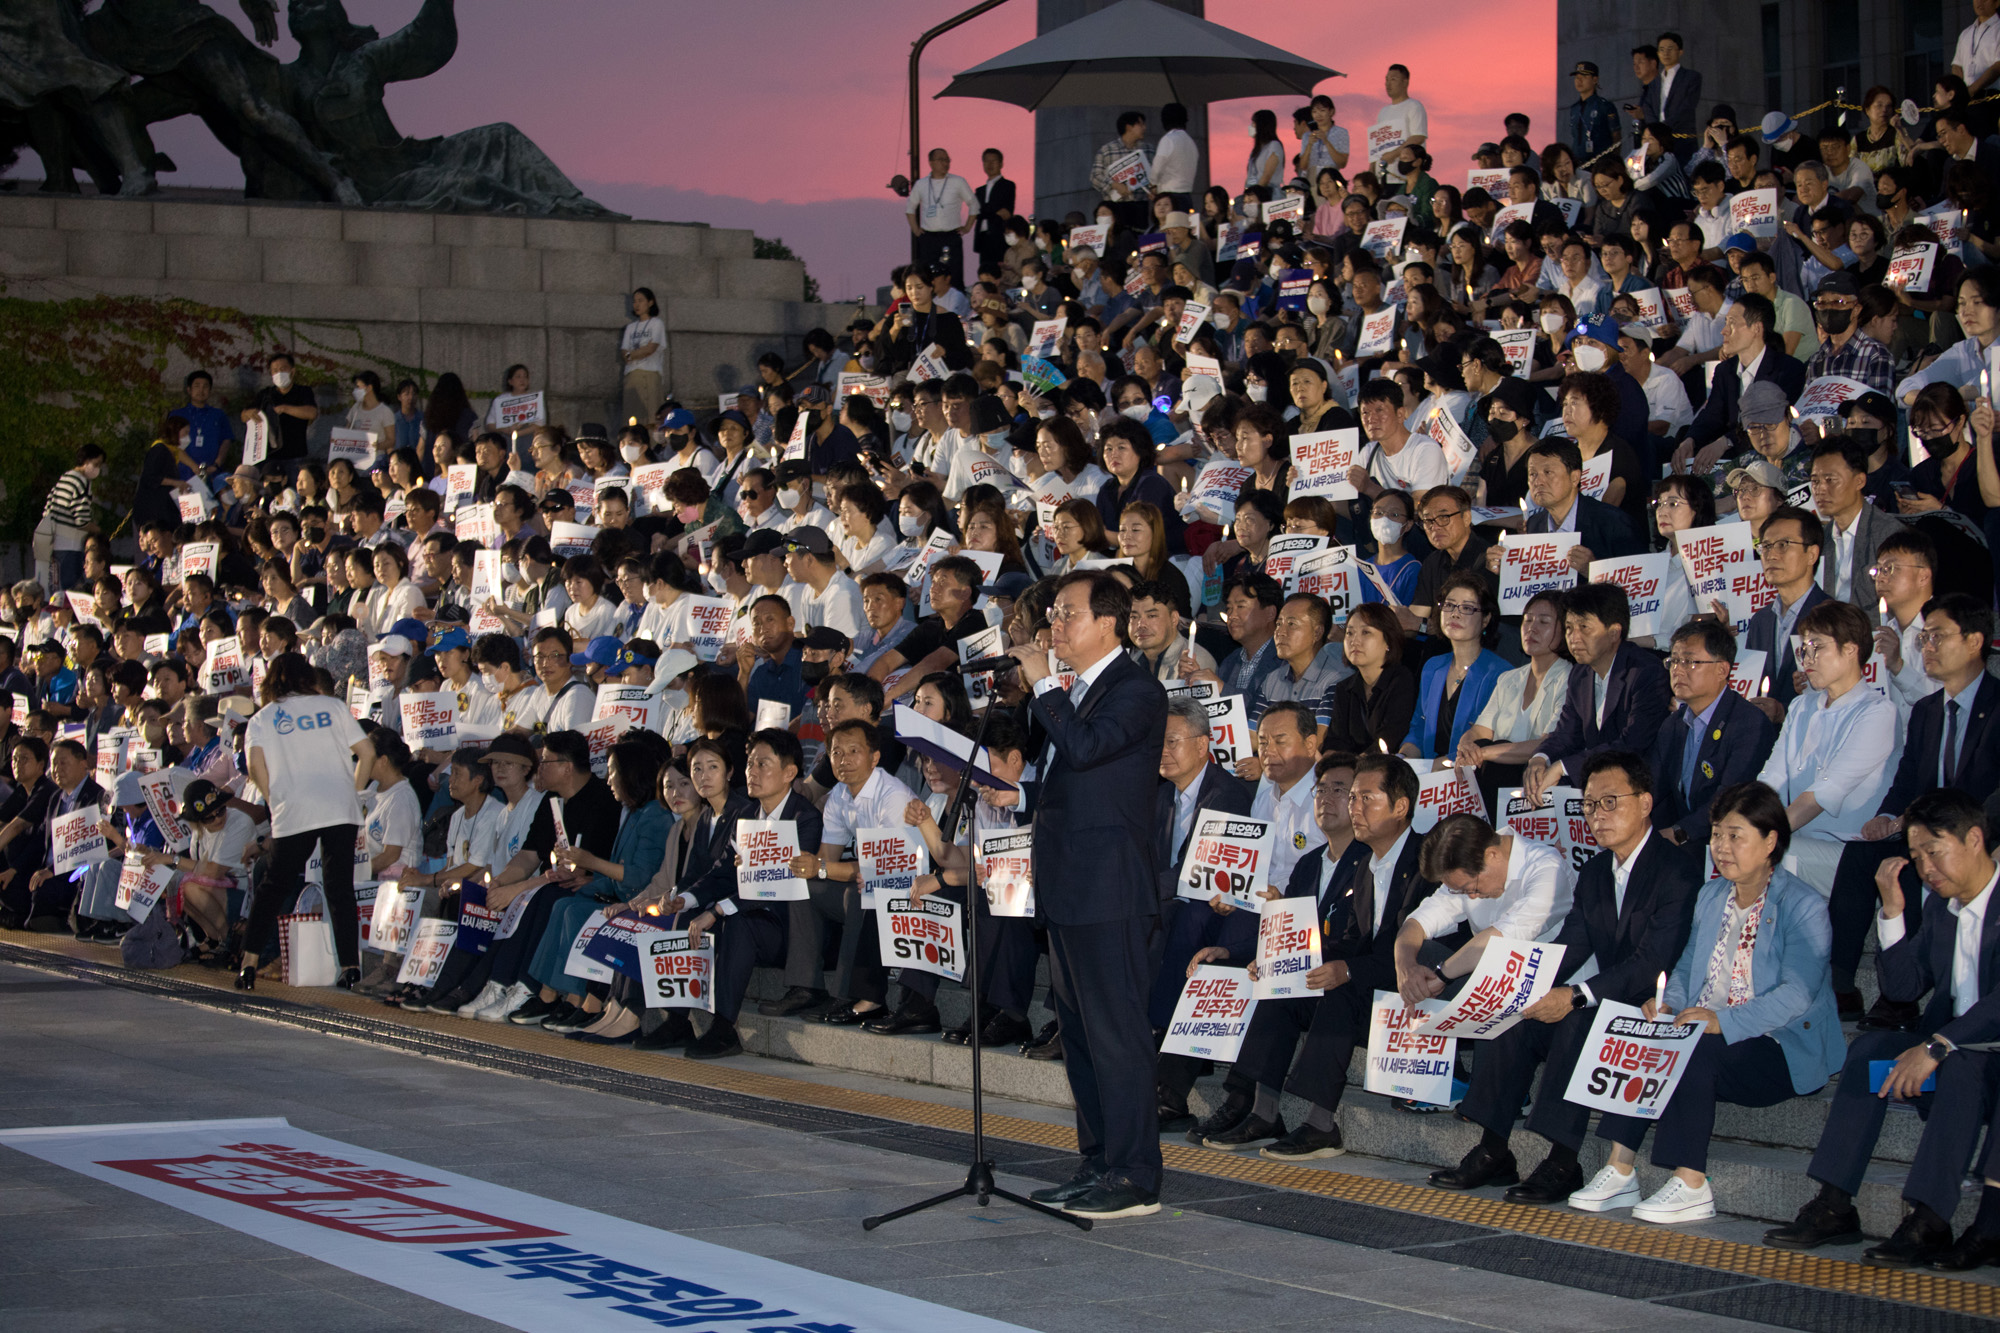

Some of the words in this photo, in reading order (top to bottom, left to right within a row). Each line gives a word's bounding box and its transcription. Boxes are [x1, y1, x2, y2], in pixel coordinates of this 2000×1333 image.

[502, 402, 537, 415] 해양투기
[502, 410, 537, 423] STOP!
[1296, 439, 1339, 461] 무너지는
[1308, 450, 1353, 475] 민주주의
[973, 469, 991, 483] 다시
[1201, 467, 1251, 481] 무너지는
[1294, 479, 1311, 492] 다시
[1284, 538, 1314, 551] 핵오염수
[1506, 543, 1557, 566] 무너지는
[1681, 536, 1724, 560] 무너지는
[1519, 559, 1569, 583] 민주주의
[1299, 571, 1348, 595] 해양투기
[1503, 583, 1522, 600] 다시
[691, 605, 732, 620] 무너지는
[211, 671, 243, 688] STOP!
[403, 699, 435, 716] 무너지는
[411, 710, 452, 728] 민주주의
[1419, 780, 1471, 808] 무너지는
[55, 816, 86, 838] 무너지는
[64, 825, 99, 848] 민주주의
[1227, 823, 1262, 837] 핵오염수
[740, 830, 778, 849] 무너지는
[862, 837, 905, 859] 무너지는
[984, 840, 1009, 853] 후쿠시마
[1009, 834, 1032, 848] 핵오염수
[56, 849, 68, 863] 다시
[749, 846, 793, 868] 민주주의
[1195, 838, 1259, 873] 해양투기
[740, 871, 751, 884] 다시
[985, 857, 1031, 878] 해양투기
[1189, 864, 1255, 900] STOP!
[465, 904, 490, 917] 무너지는
[890, 900, 924, 913] 후쿠시마
[924, 901, 951, 915] 핵오염수
[461, 915, 475, 928] 다시
[599, 926, 615, 937] 다시
[612, 917, 633, 929] 무너지는
[891, 915, 954, 947] 해양투기
[1260, 911, 1293, 940] 무너지는
[653, 939, 689, 953] 후쿠시마
[1265, 928, 1312, 958] 민주주의
[893, 938, 955, 971] STOP!
[406, 959, 441, 979] STOP!
[654, 956, 710, 976] 해양투기
[1186, 978, 1239, 998] 무너지는
[1470, 950, 1525, 1023] 민주주의
[1474, 1020, 1499, 1035] 다시
[1499, 947, 1543, 1022] 세우겠습니다
[1191, 999, 1249, 1018] 민주주의
[1435, 975, 1498, 1032] 무너지는
[1171, 1022, 1192, 1036] 다시
[1191, 1022, 1245, 1037] 세우겠습니다
[1610, 1018, 1657, 1036] 후쿠시마
[1655, 1024, 1692, 1038] 핵오염수
[1387, 1032, 1447, 1055] 민주주의
[1372, 1057, 1389, 1072] 다시
[1389, 1058, 1449, 1077] 세우겠습니다
[1599, 1037, 1680, 1077] 해양투기
[1587, 1066, 1667, 1107] STOP!
[434, 1242, 799, 1327] 민주주의
